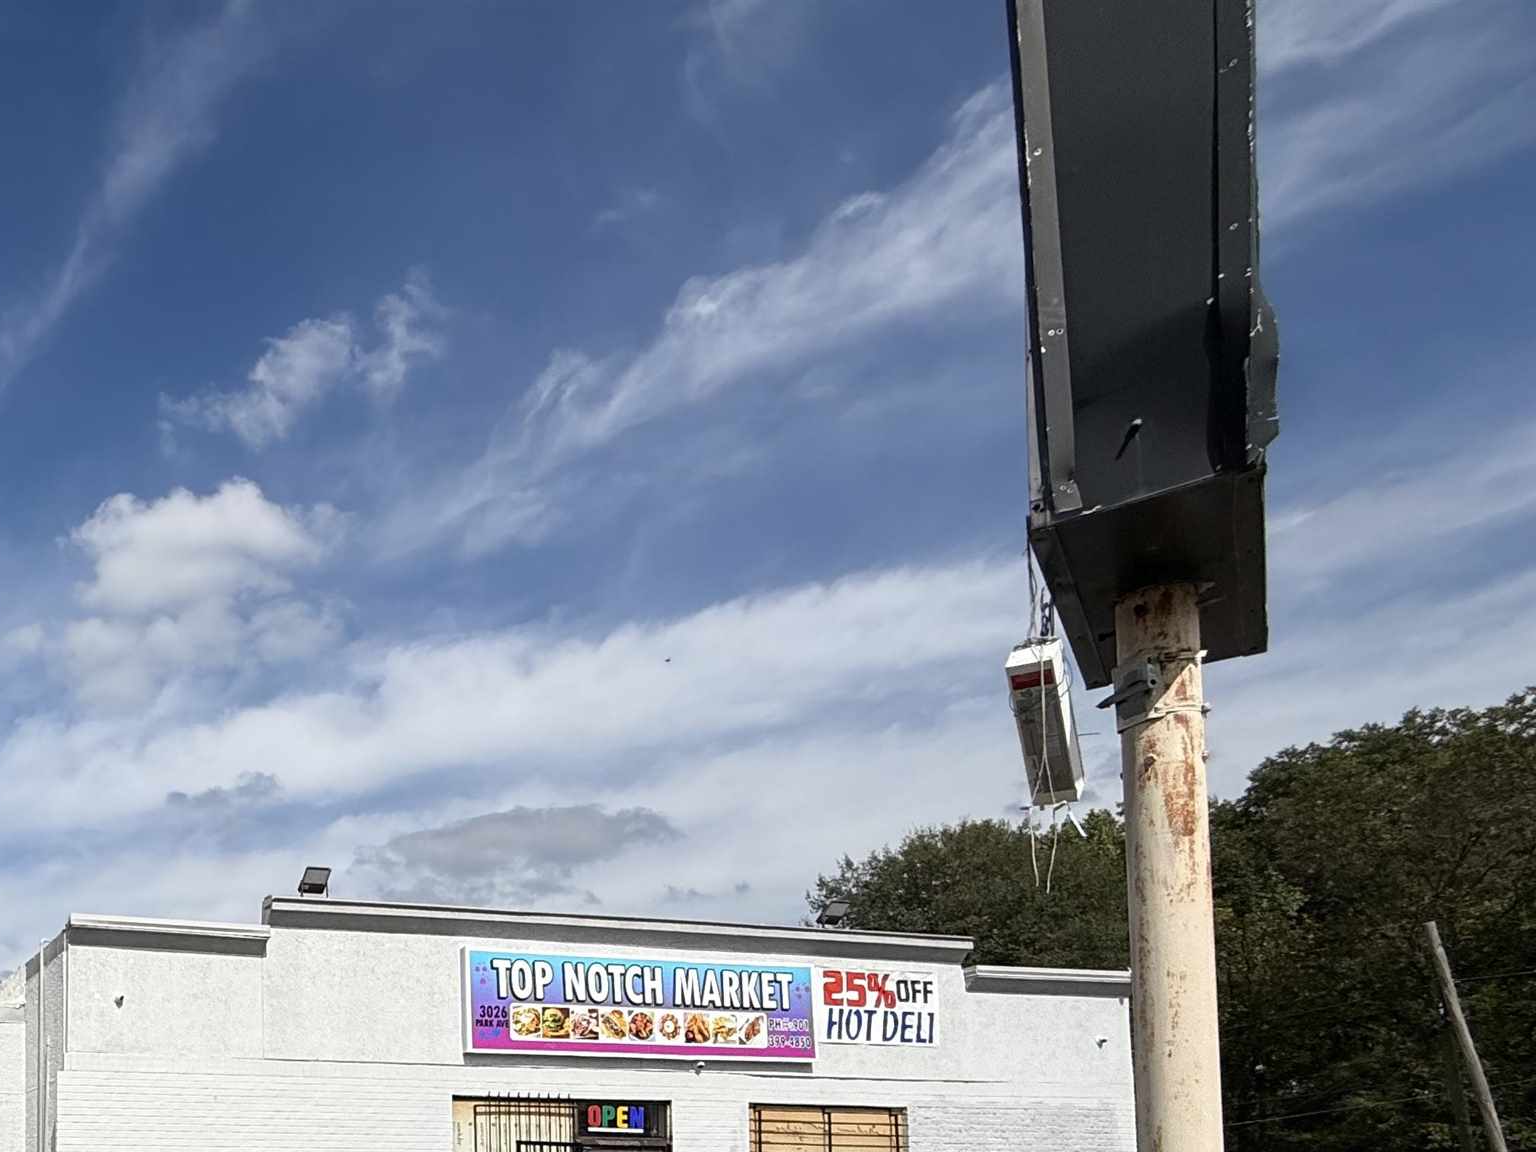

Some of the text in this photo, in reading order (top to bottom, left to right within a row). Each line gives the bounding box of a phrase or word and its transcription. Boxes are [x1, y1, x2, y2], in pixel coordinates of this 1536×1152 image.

[491, 958, 794, 1011] TOP NOTCH MARKET
[822, 970, 933, 1009] 25% OFF
[475, 1019, 510, 1029] PARK AVE
[479, 1005, 508, 1019] 3026
[826, 1008, 934, 1044] HOT DELI
[587, 1104, 645, 1129] OPEN
